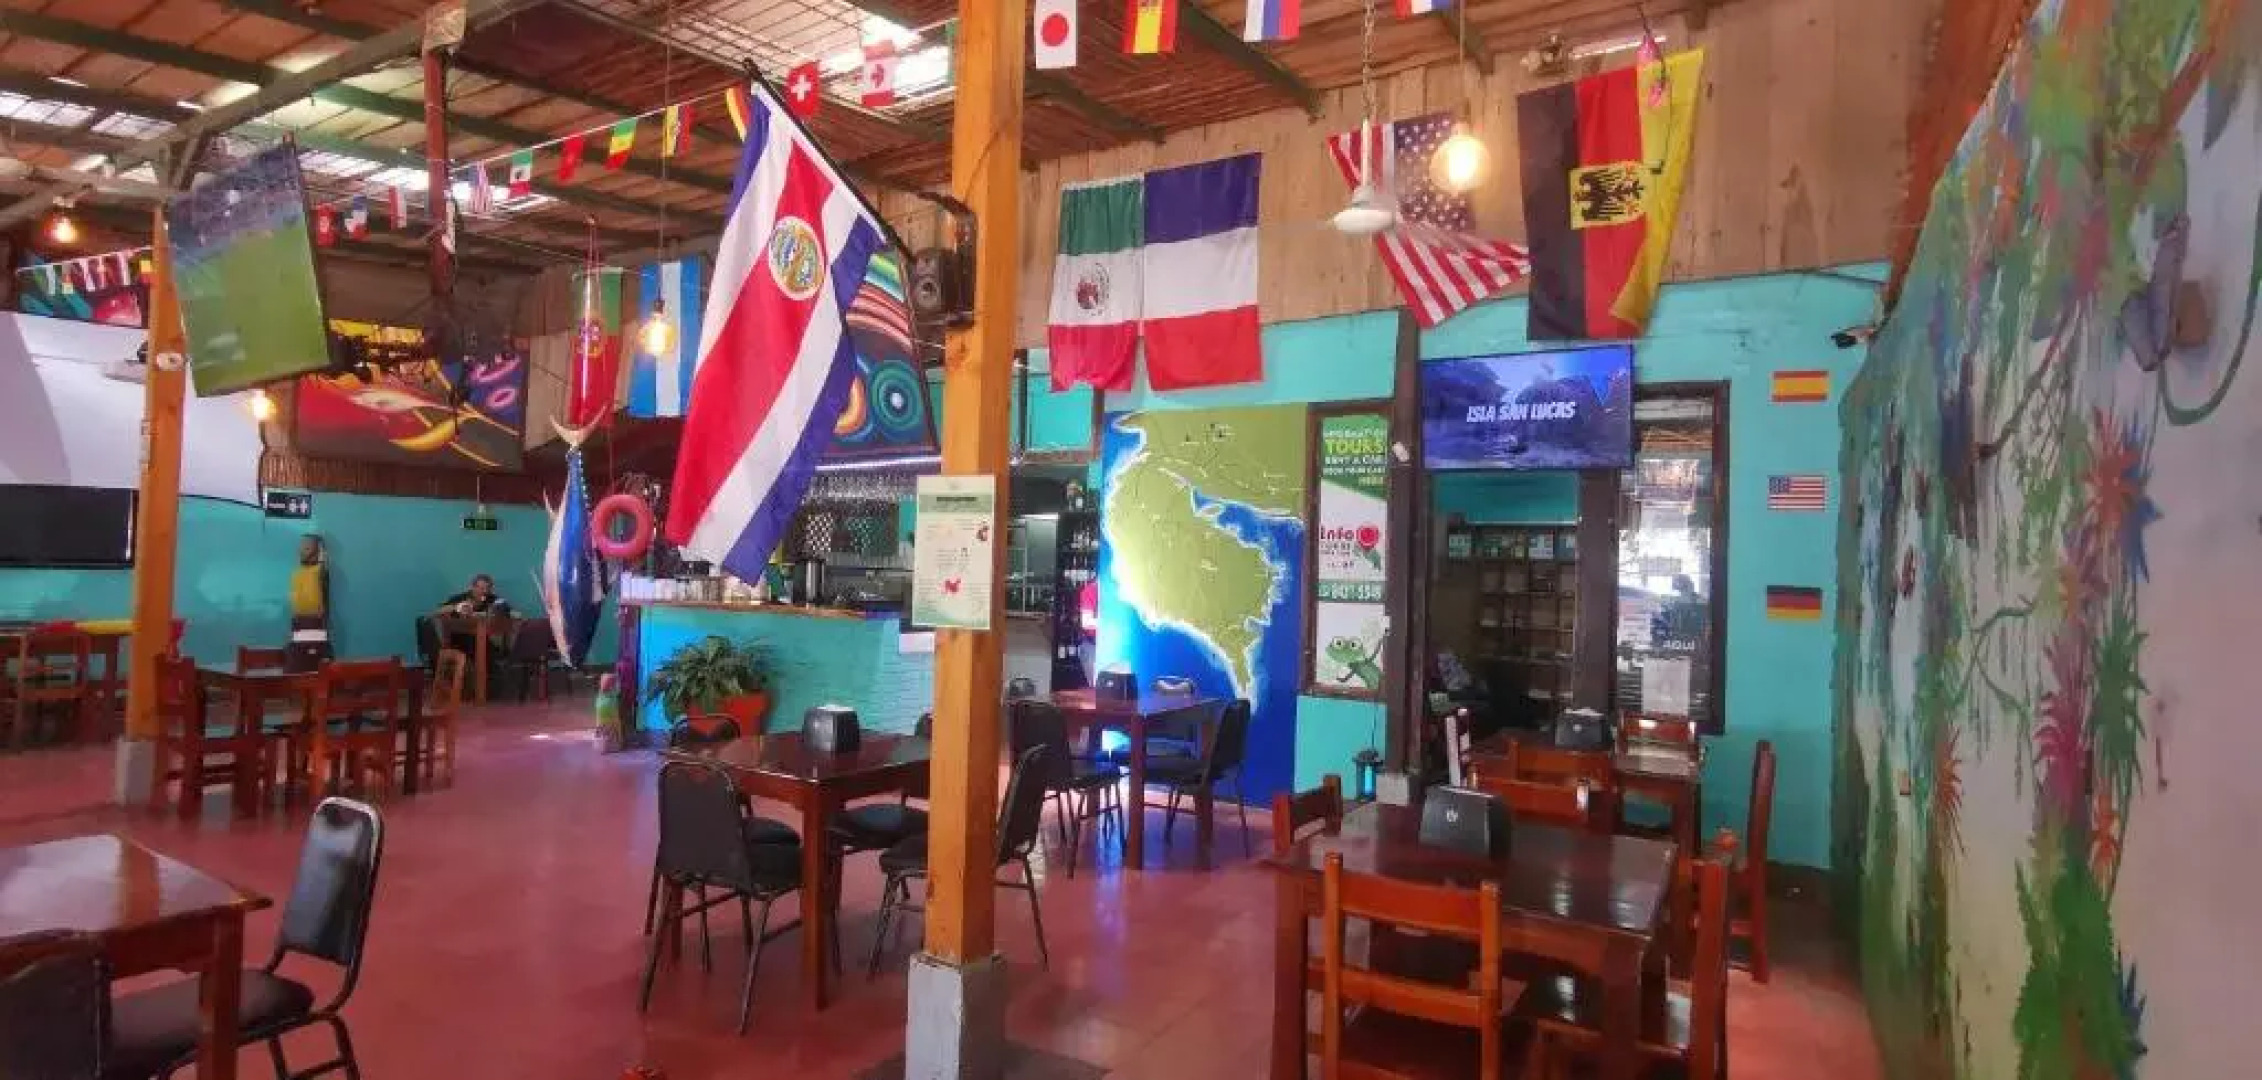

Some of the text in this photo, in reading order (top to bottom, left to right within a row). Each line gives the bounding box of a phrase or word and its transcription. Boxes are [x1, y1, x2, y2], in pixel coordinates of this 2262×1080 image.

[1466, 401, 1576, 423] ISLA SAN LUCAS
[1325, 438, 1384, 454] TOURS
